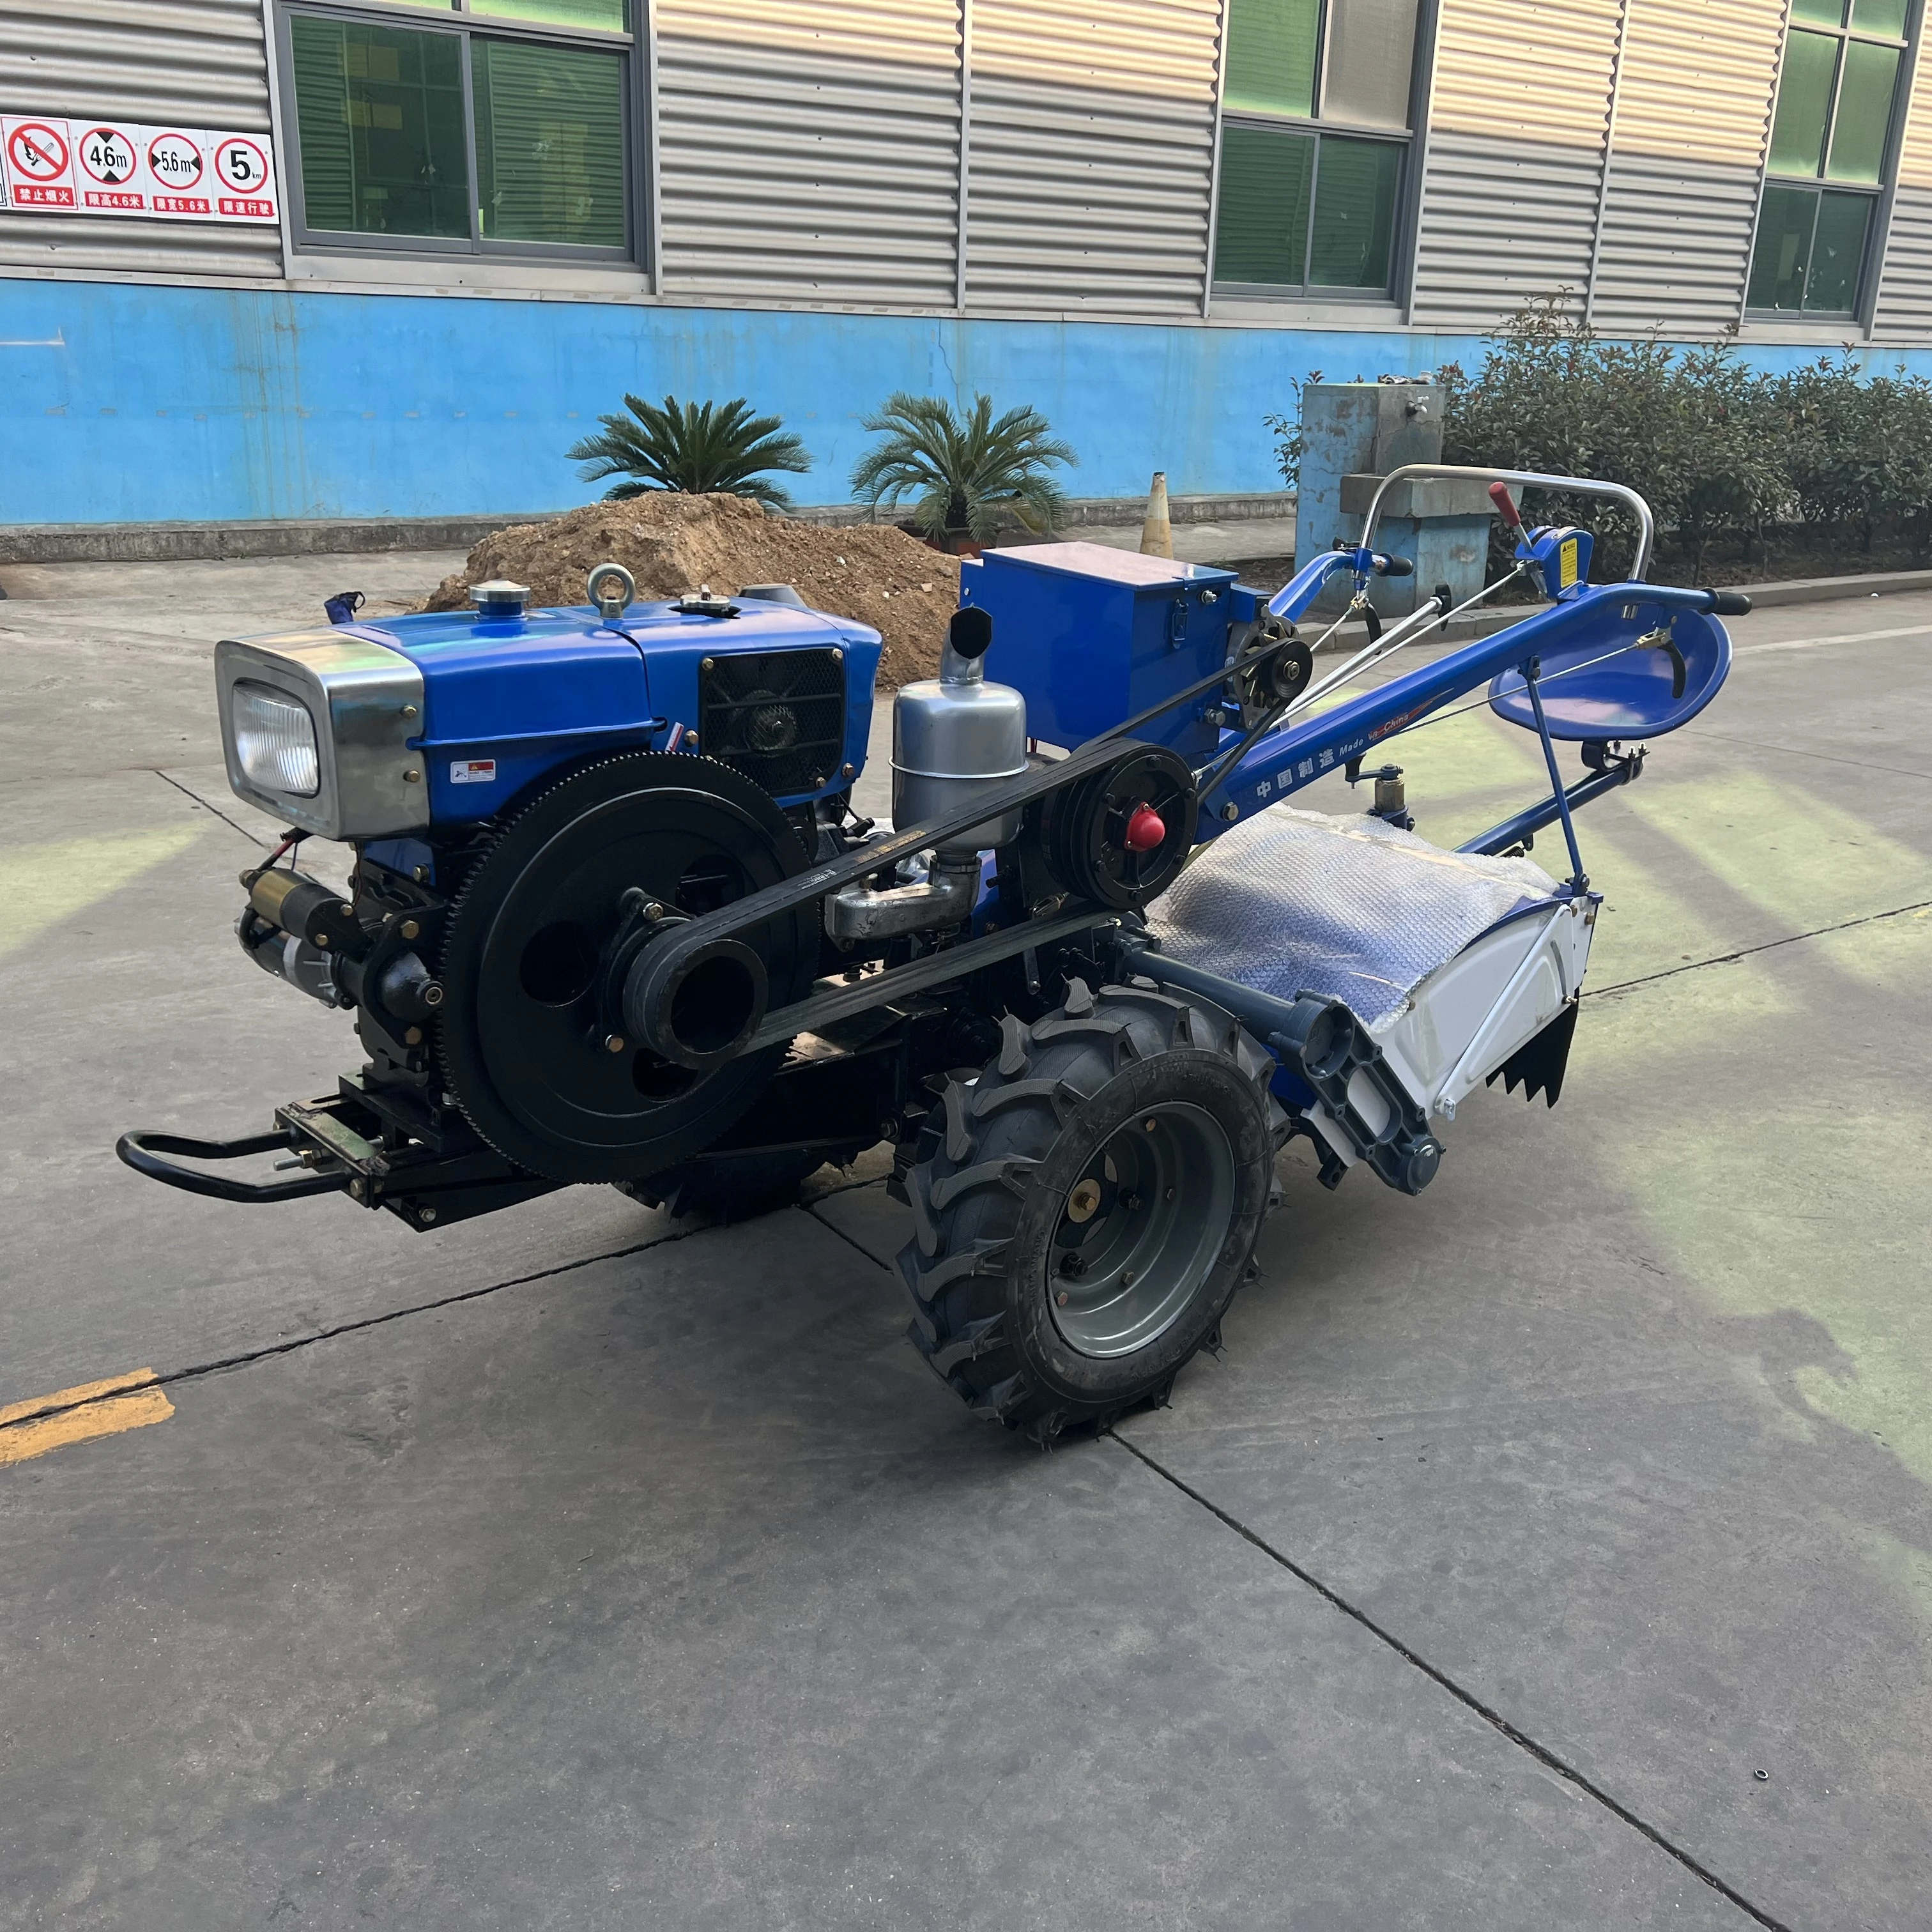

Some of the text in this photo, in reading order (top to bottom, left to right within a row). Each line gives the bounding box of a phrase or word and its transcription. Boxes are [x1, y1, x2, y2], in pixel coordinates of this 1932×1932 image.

[90, 145, 127, 168] 4.6m
[230, 150, 250, 180] 5
[19, 188, 70, 203] 禁止烟火
[88, 192, 141, 208] 限高4.6米
[156, 197, 206, 212] 限宽5.6米
[223, 200, 270, 215] 限速行驶
[1256, 748, 1335, 798] 中国制造
[1338, 739, 1363, 756] Made
[1384, 712, 1409, 732] China
